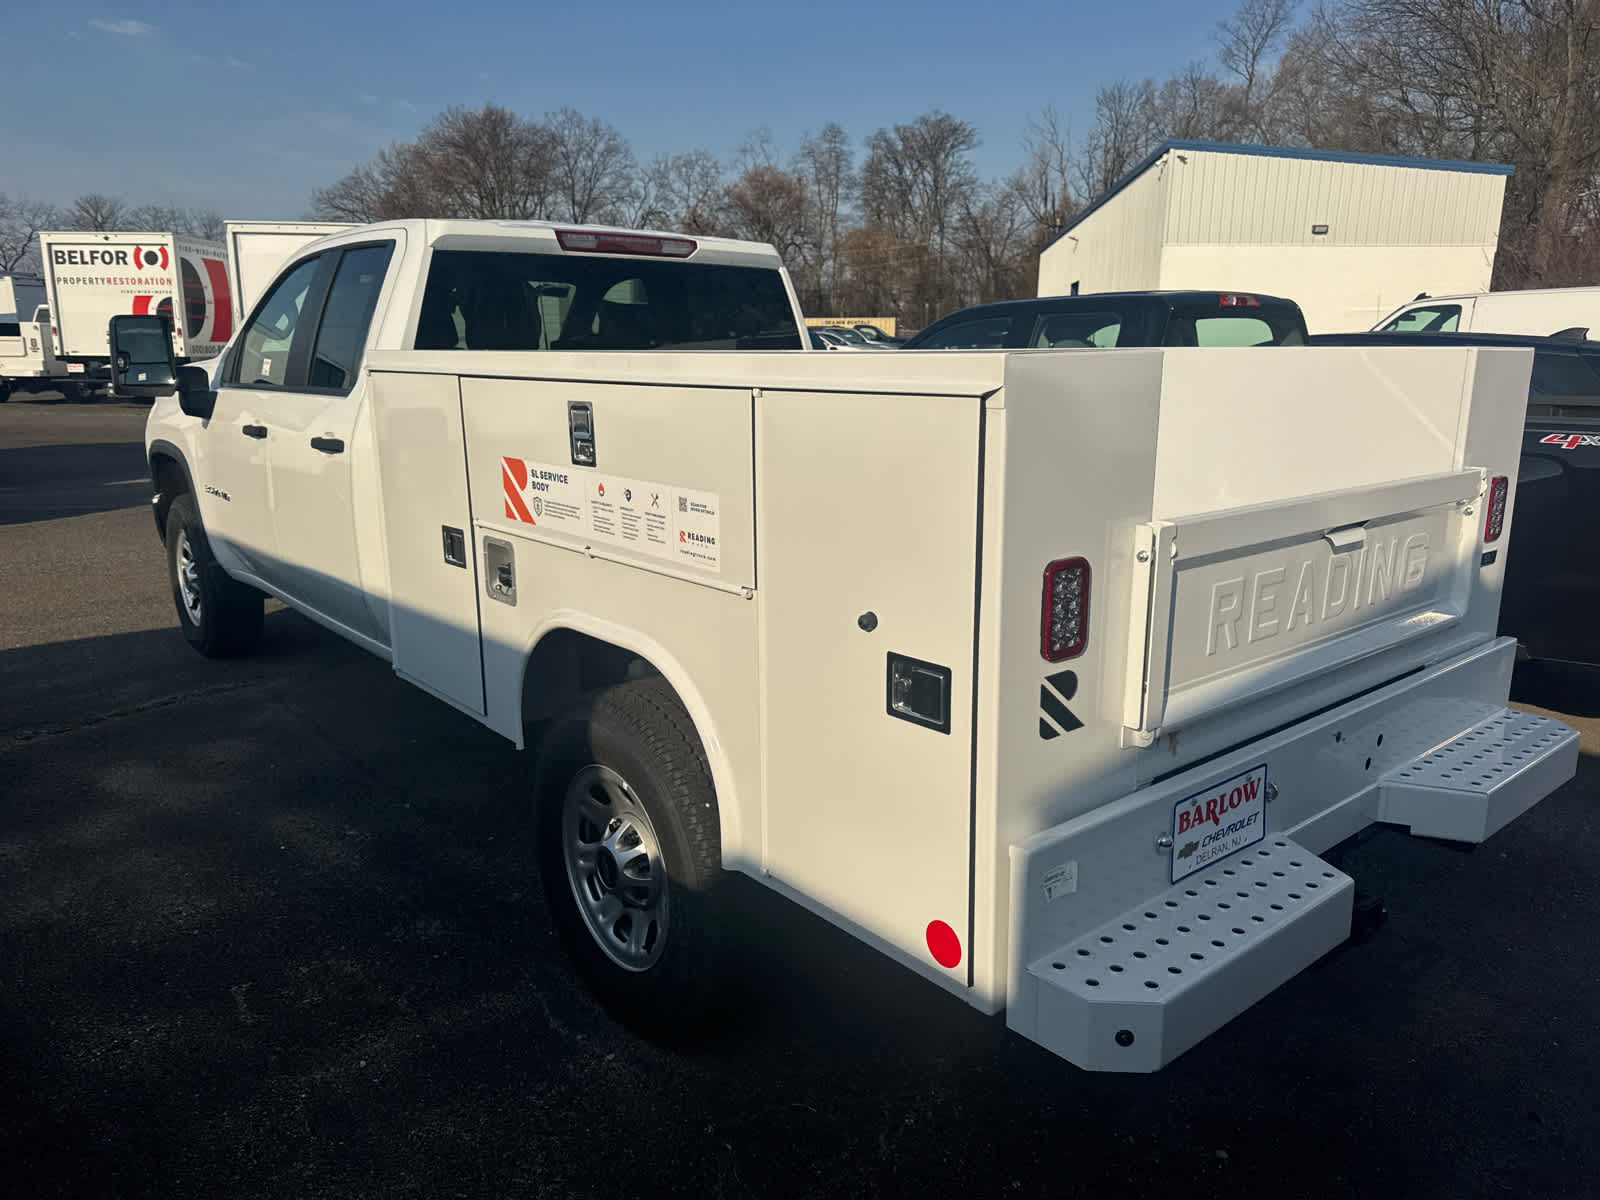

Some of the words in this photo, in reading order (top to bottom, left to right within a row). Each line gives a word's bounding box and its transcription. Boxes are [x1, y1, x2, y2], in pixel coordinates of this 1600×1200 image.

[54, 250, 128, 265] BELFOR
[531, 468, 539, 479] SL
[540, 470, 568, 484] SERVICE
[532, 480, 549, 492] BODY
[687, 532, 716, 545] READING
[1205, 532, 1430, 656] READING
[1177, 777, 1261, 835] BARLOW
[1202, 811, 1260, 848] CHEVROLET
[1231, 837, 1242, 852] NJ
